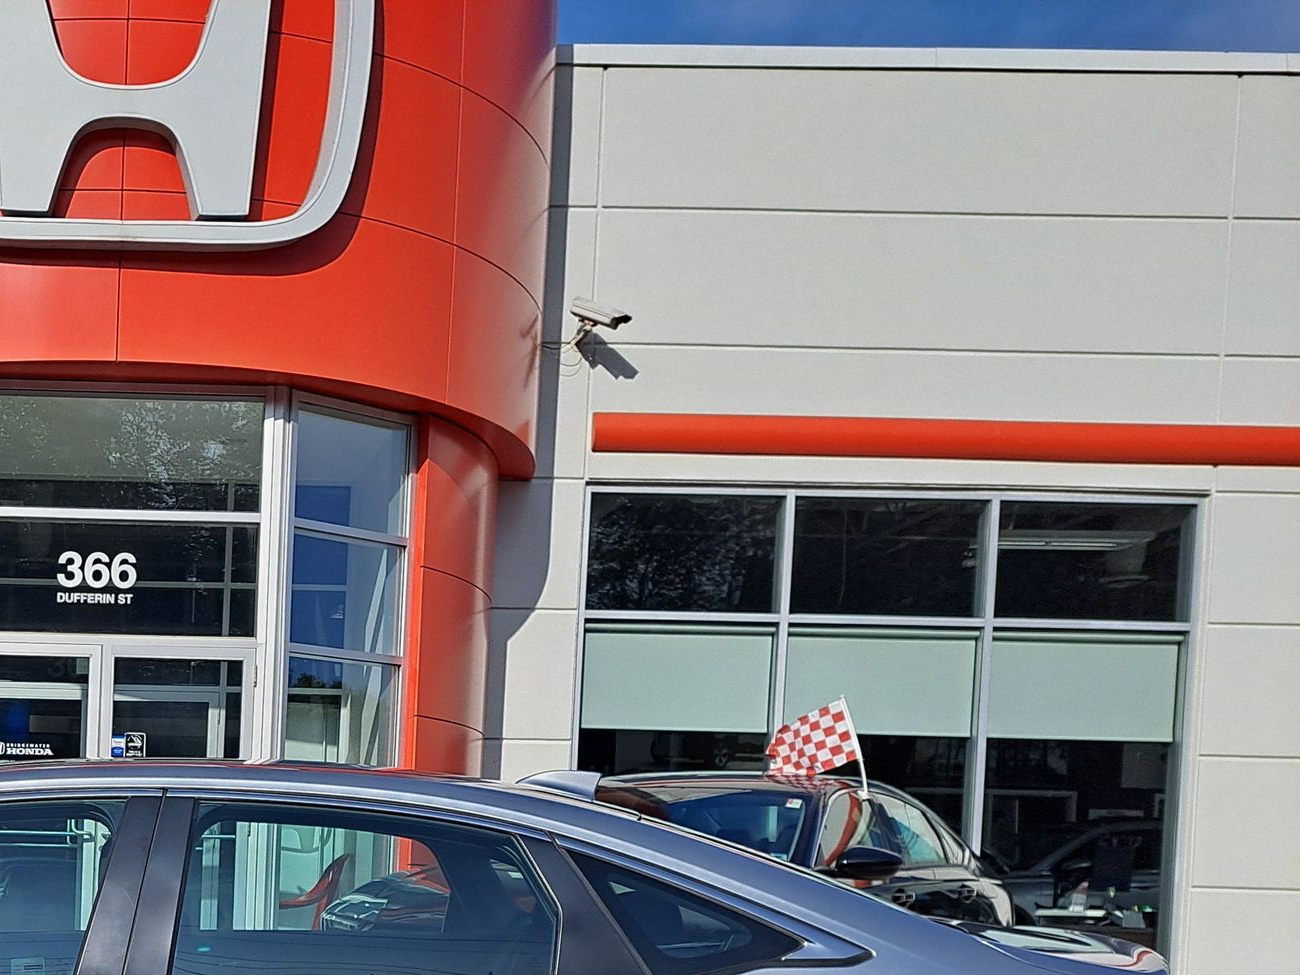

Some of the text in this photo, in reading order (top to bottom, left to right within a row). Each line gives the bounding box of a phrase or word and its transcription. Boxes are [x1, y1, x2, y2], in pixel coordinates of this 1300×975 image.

[56, 550, 137, 589] 366
[56, 591, 134, 605] DUFFERIN ST
[6, 747, 54, 756] HONDA
